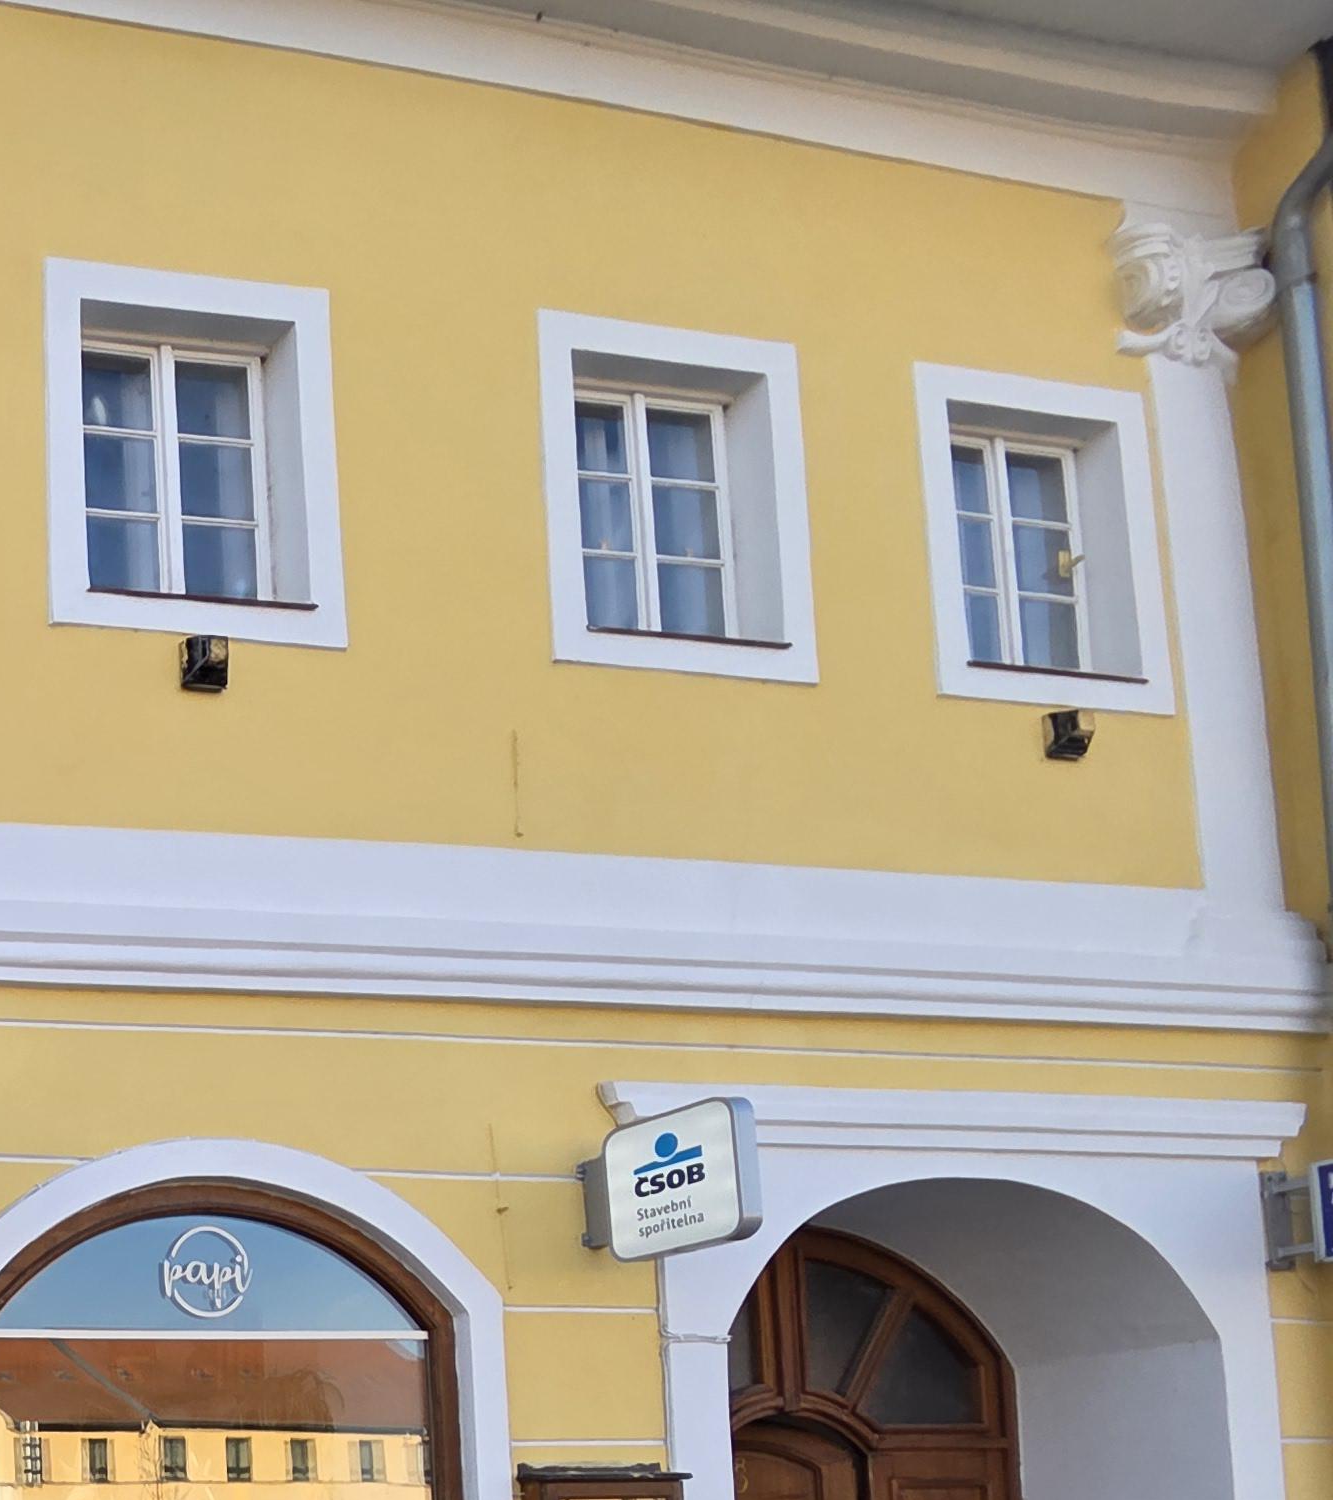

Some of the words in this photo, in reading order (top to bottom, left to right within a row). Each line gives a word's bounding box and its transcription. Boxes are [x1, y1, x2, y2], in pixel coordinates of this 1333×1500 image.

[634, 1162, 706, 1198] ČSOB
[636, 1195, 693, 1222] Stavební
[638, 1211, 706, 1239] spořitelna
[163, 1254, 253, 1309] papi
